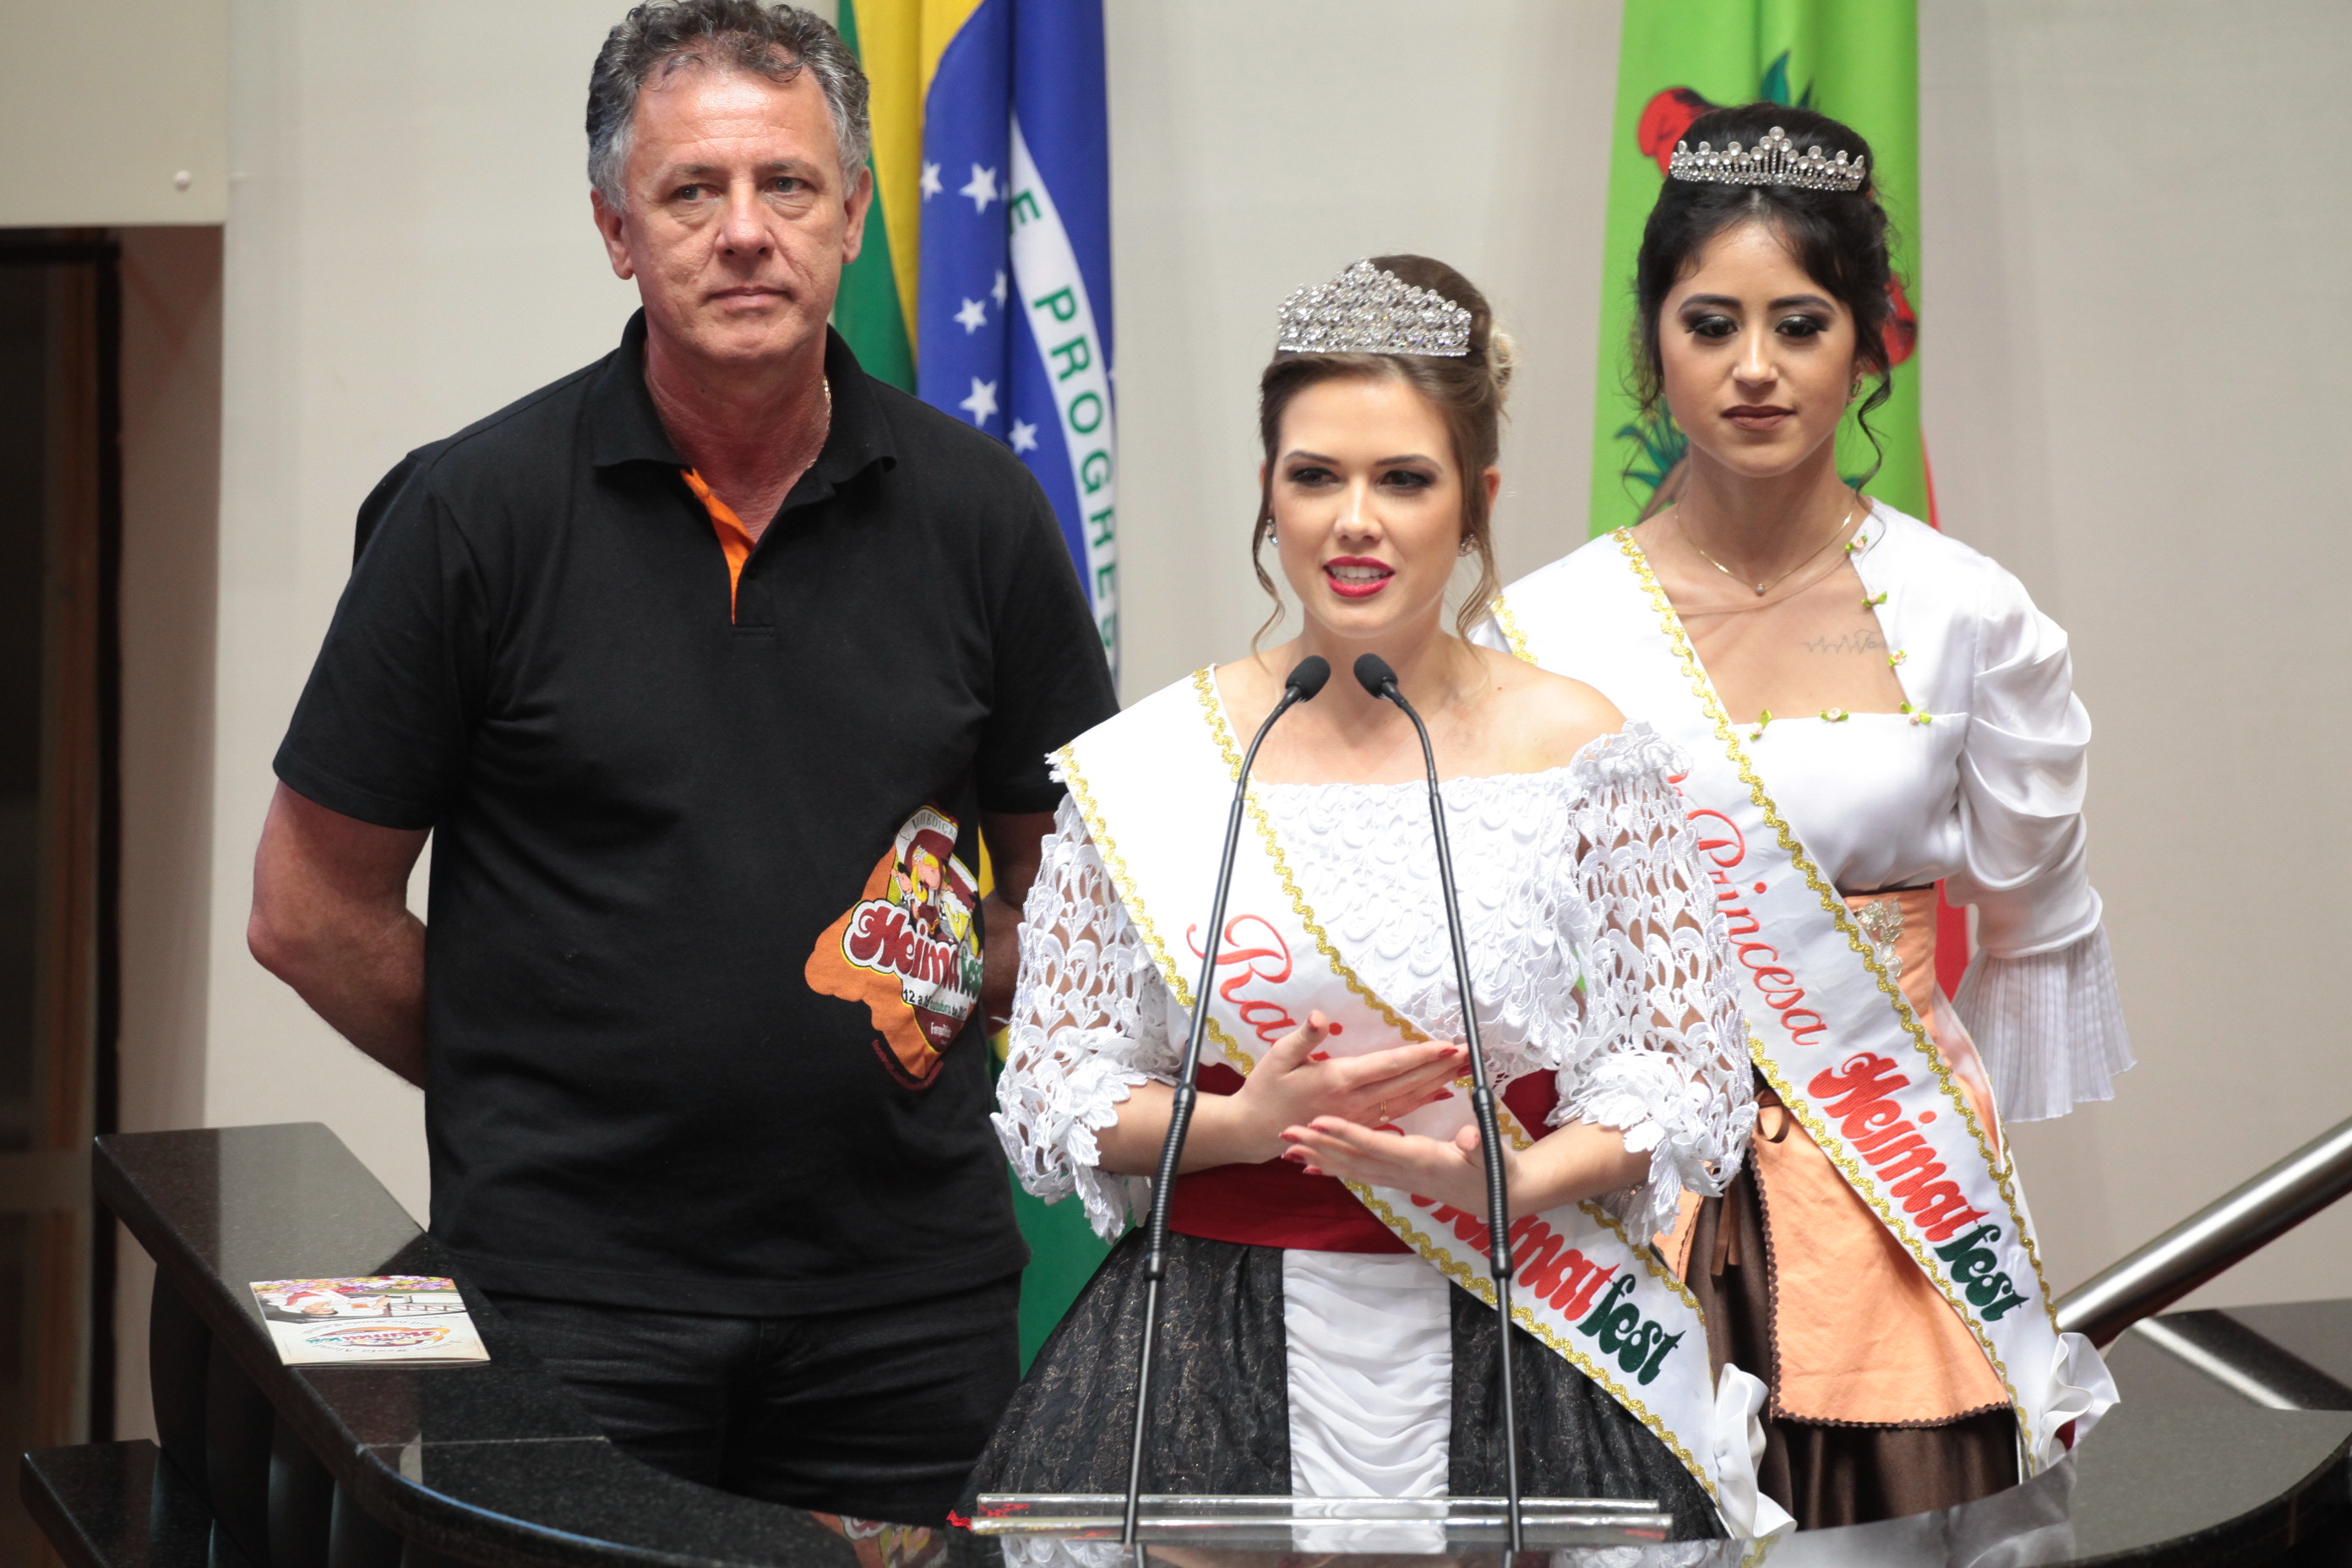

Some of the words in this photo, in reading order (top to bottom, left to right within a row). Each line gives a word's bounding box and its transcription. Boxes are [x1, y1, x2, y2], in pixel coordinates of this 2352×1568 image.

[1009, 189, 1042, 235] E
[1033, 284, 1116, 674] PROGRES
[903, 988, 915, 1003] 12
[1808, 1052, 2029, 1321] Heimatfest
